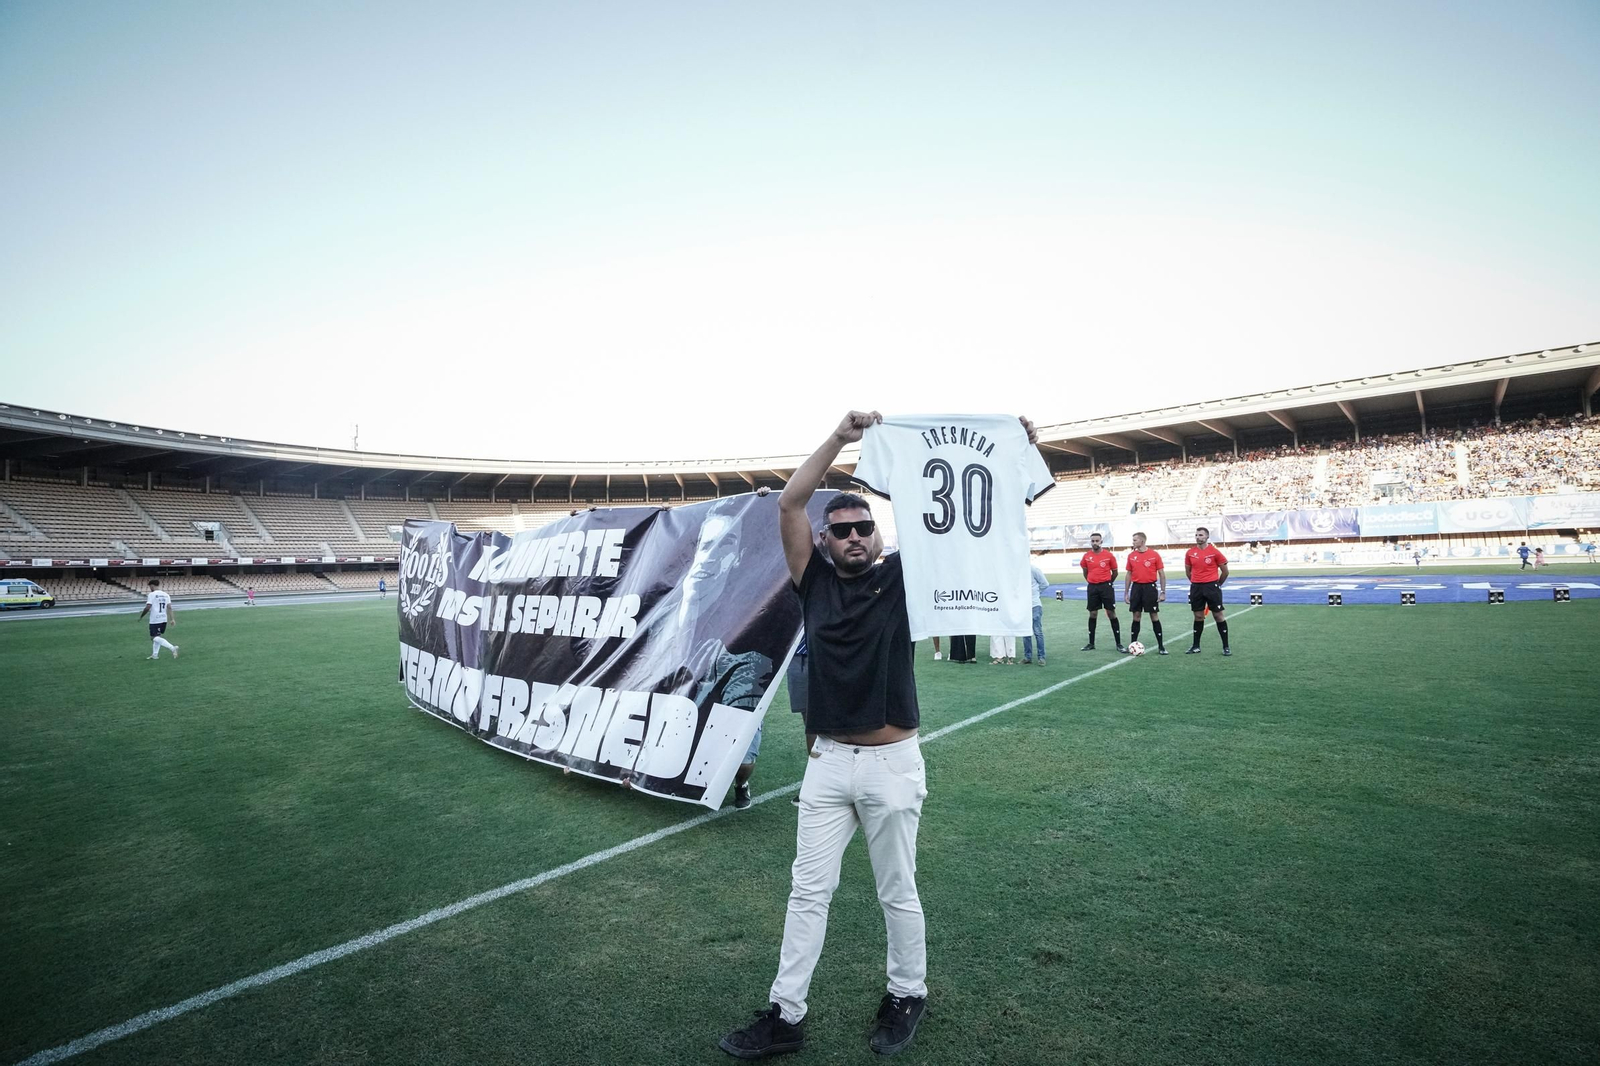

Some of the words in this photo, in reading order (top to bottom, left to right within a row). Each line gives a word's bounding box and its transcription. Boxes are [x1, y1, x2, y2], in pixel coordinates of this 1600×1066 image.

[921, 426, 996, 458] FRESNEDA
[922, 457, 993, 538] 30
[508, 594, 641, 639] SEPARAR
